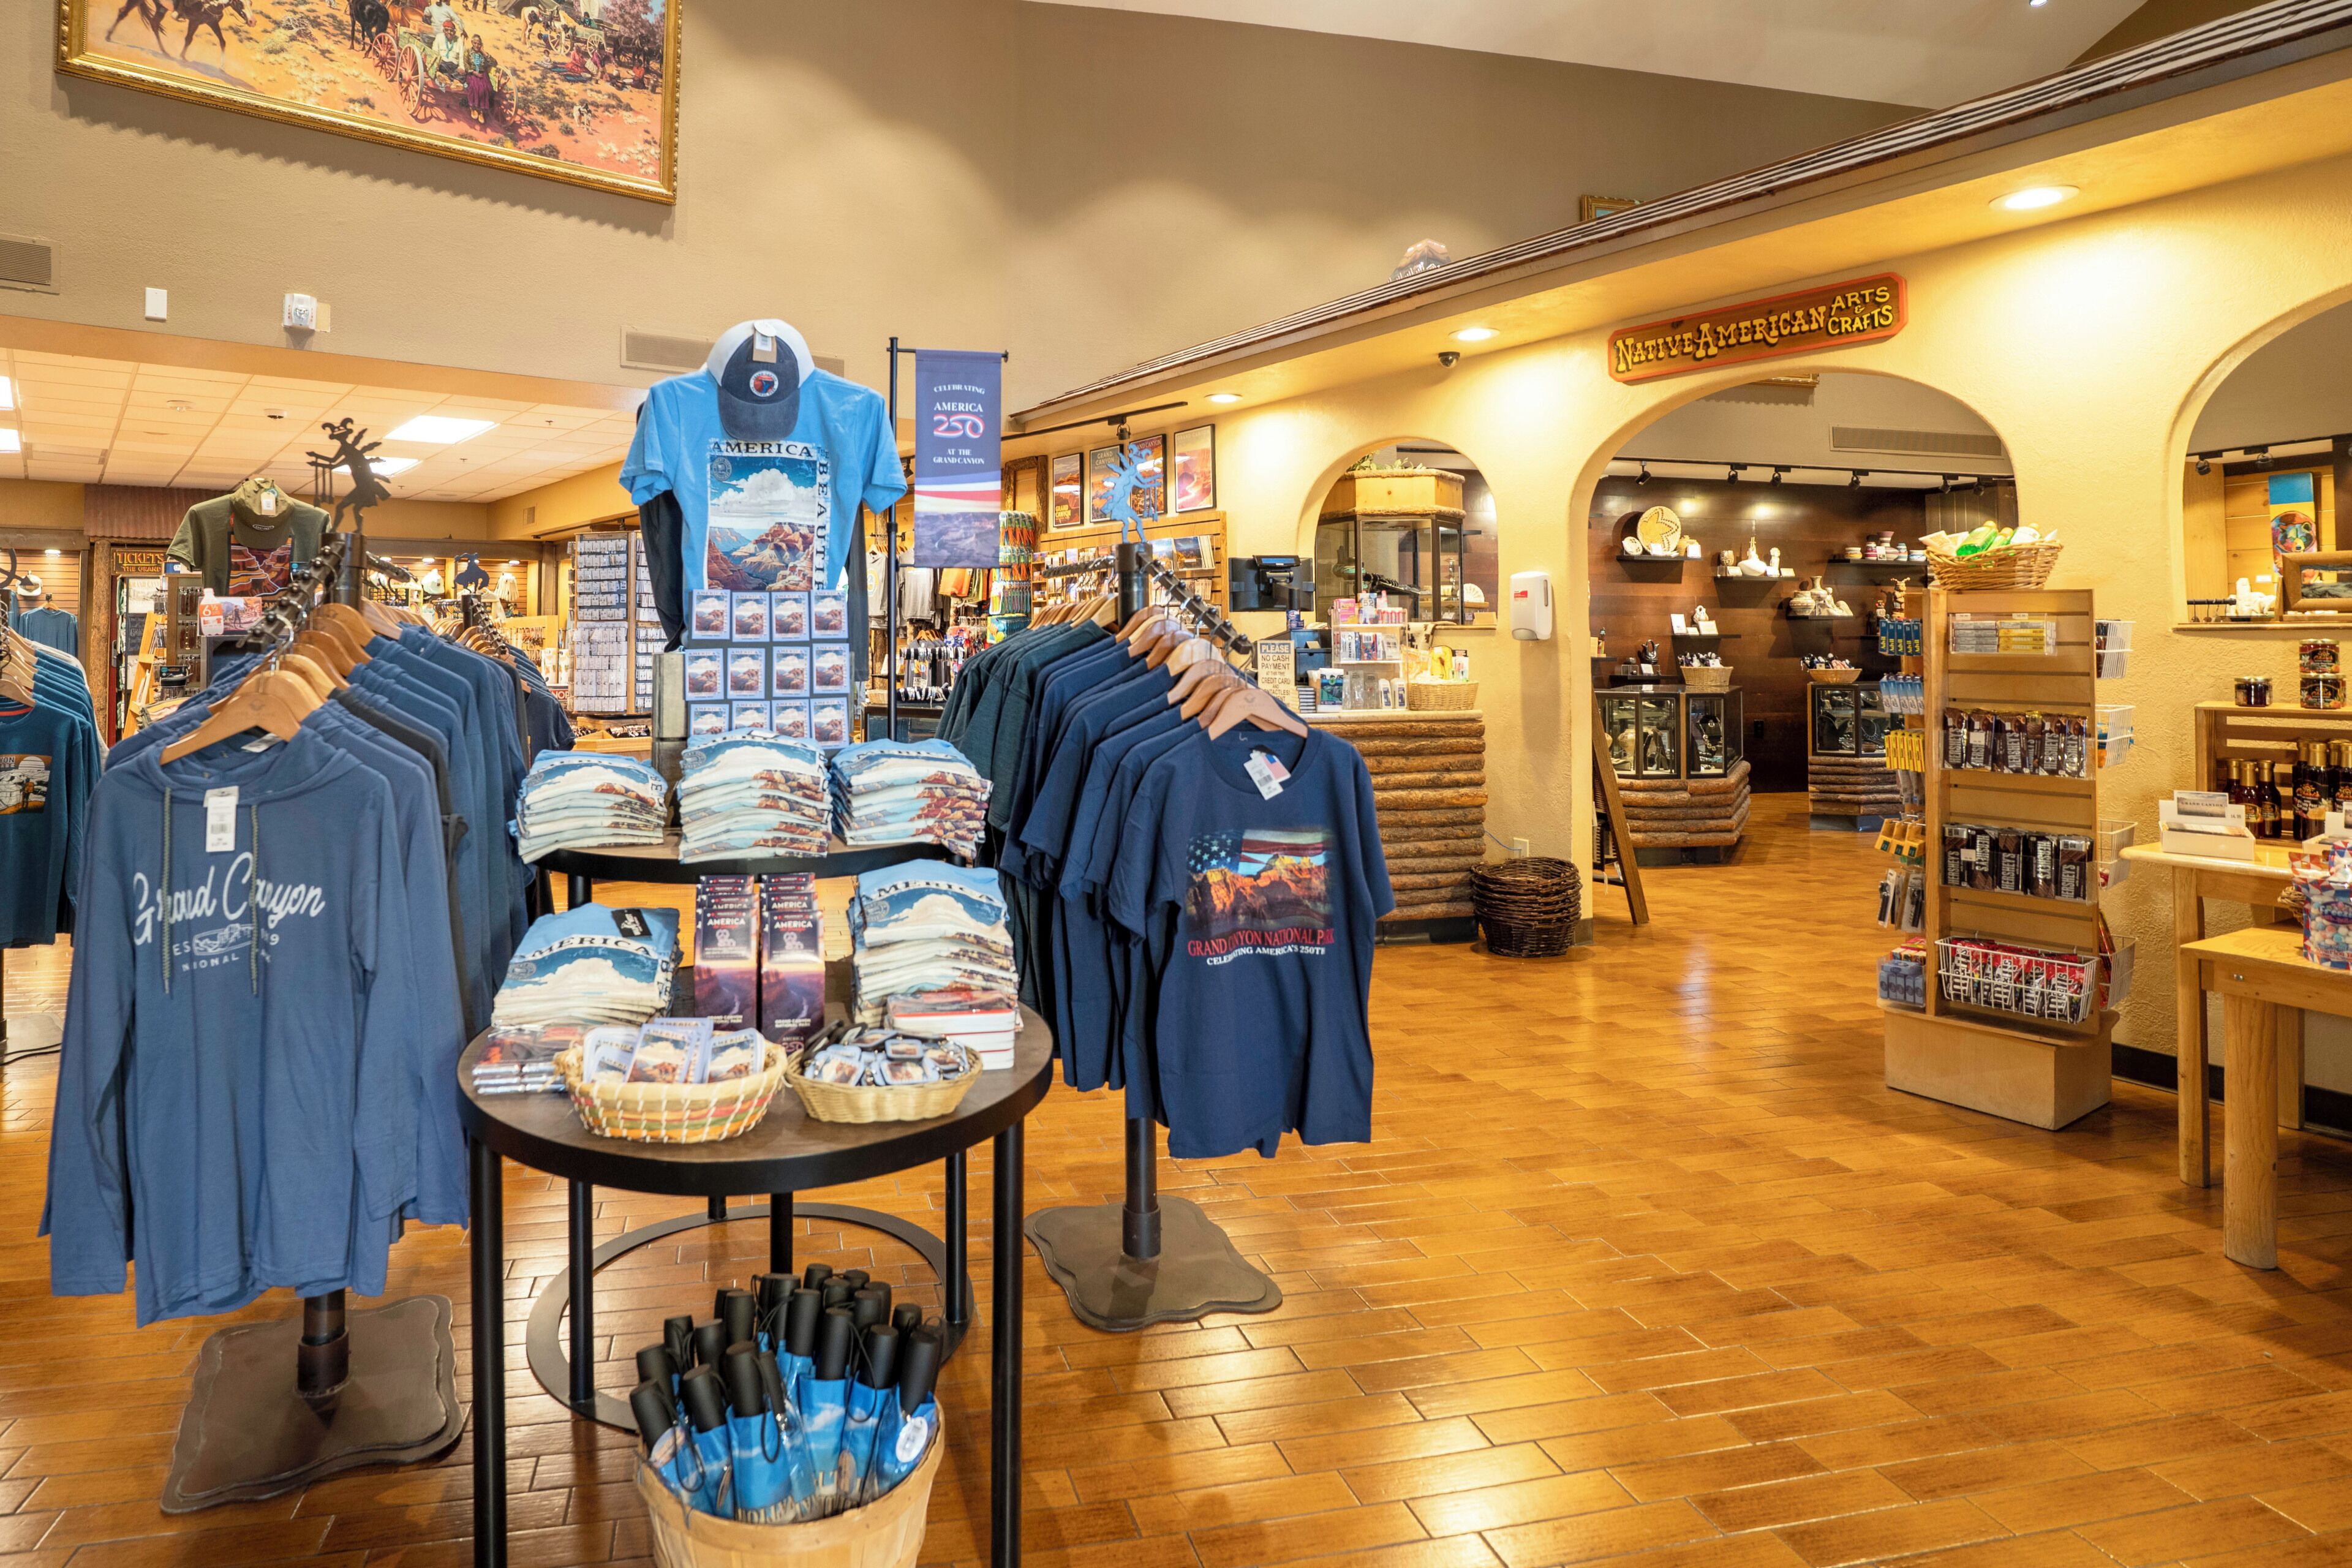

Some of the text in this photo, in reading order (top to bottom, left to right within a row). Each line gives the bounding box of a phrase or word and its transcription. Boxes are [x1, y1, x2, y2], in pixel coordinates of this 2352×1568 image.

[1831, 285, 1890, 315] ARTS
[1854, 304, 1865, 314] &
[1826, 304, 1894, 336] CRAFTS
[1616, 305, 1826, 372] NATIVE AMERICAN
[933, 384, 985, 395] CELEBRATING
[933, 402, 984, 413] AMERICA
[933, 413, 985, 439] 250
[712, 441, 813, 458] AMERICA
[1095, 457, 1115, 467] CANYON
[1097, 450, 1114, 459] GRAND
[1055, 510, 1072, 519] CANYON
[117, 552, 165, 564] TICKETS
[1948, 727, 1962, 764] HERSHEY'S
[2006, 732, 2021, 769] HERSHEY'S
[2044, 732, 2059, 770] HERSHEY'S
[1976, 834, 1991, 872] HERSHEY'S
[2037, 840, 2052, 880] HERSHEY'S
[1948, 850, 1960, 886] HERSHEY'S
[2001, 852, 2016, 891] HERSHEY'S
[2061, 864, 2076, 899] HERSHEY'S
[1188, 937, 1227, 957] GRAND
[1264, 927, 1314, 946] NATIONAL
[1255, 944, 1299, 957] AMERICA'S
[647, 1028, 686, 1040] AMERICA
[712, 1035, 749, 1047] AMERICA
